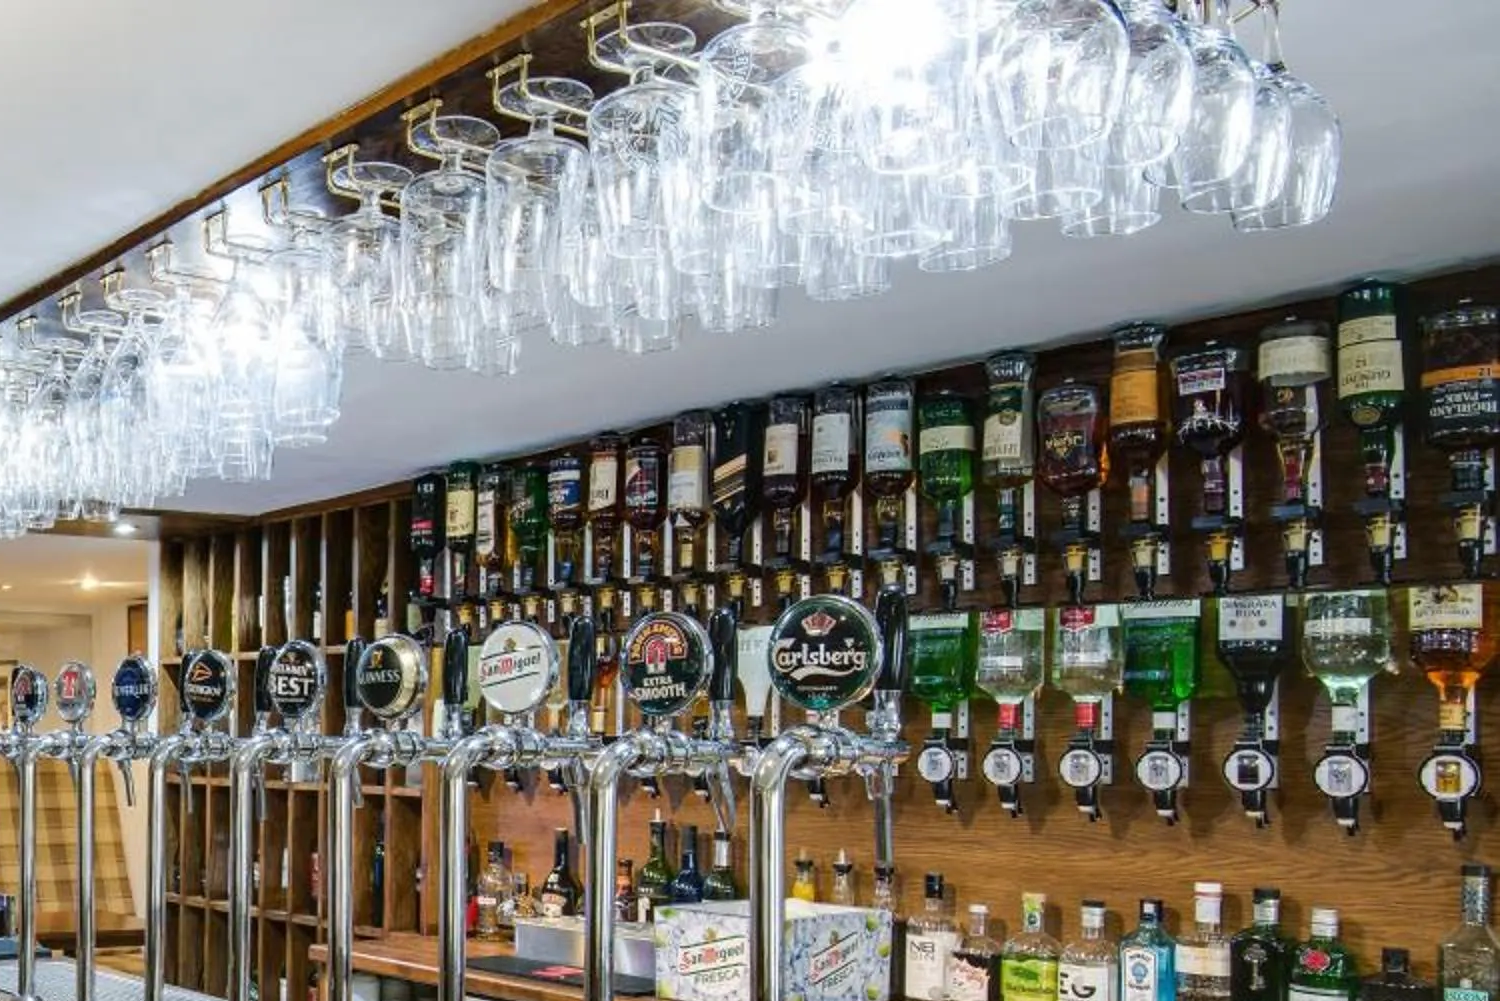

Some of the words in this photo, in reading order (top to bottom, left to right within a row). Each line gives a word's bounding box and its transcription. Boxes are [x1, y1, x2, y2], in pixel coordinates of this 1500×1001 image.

[1430, 400, 1497, 416] HIGHLAND
[772, 637, 867, 673] Carlsberg
[269, 673, 315, 697] BEST
[642, 675, 673, 687] EXTRA
[634, 682, 688, 701] SMOOTH
[693, 968, 740, 985] FRESCA
